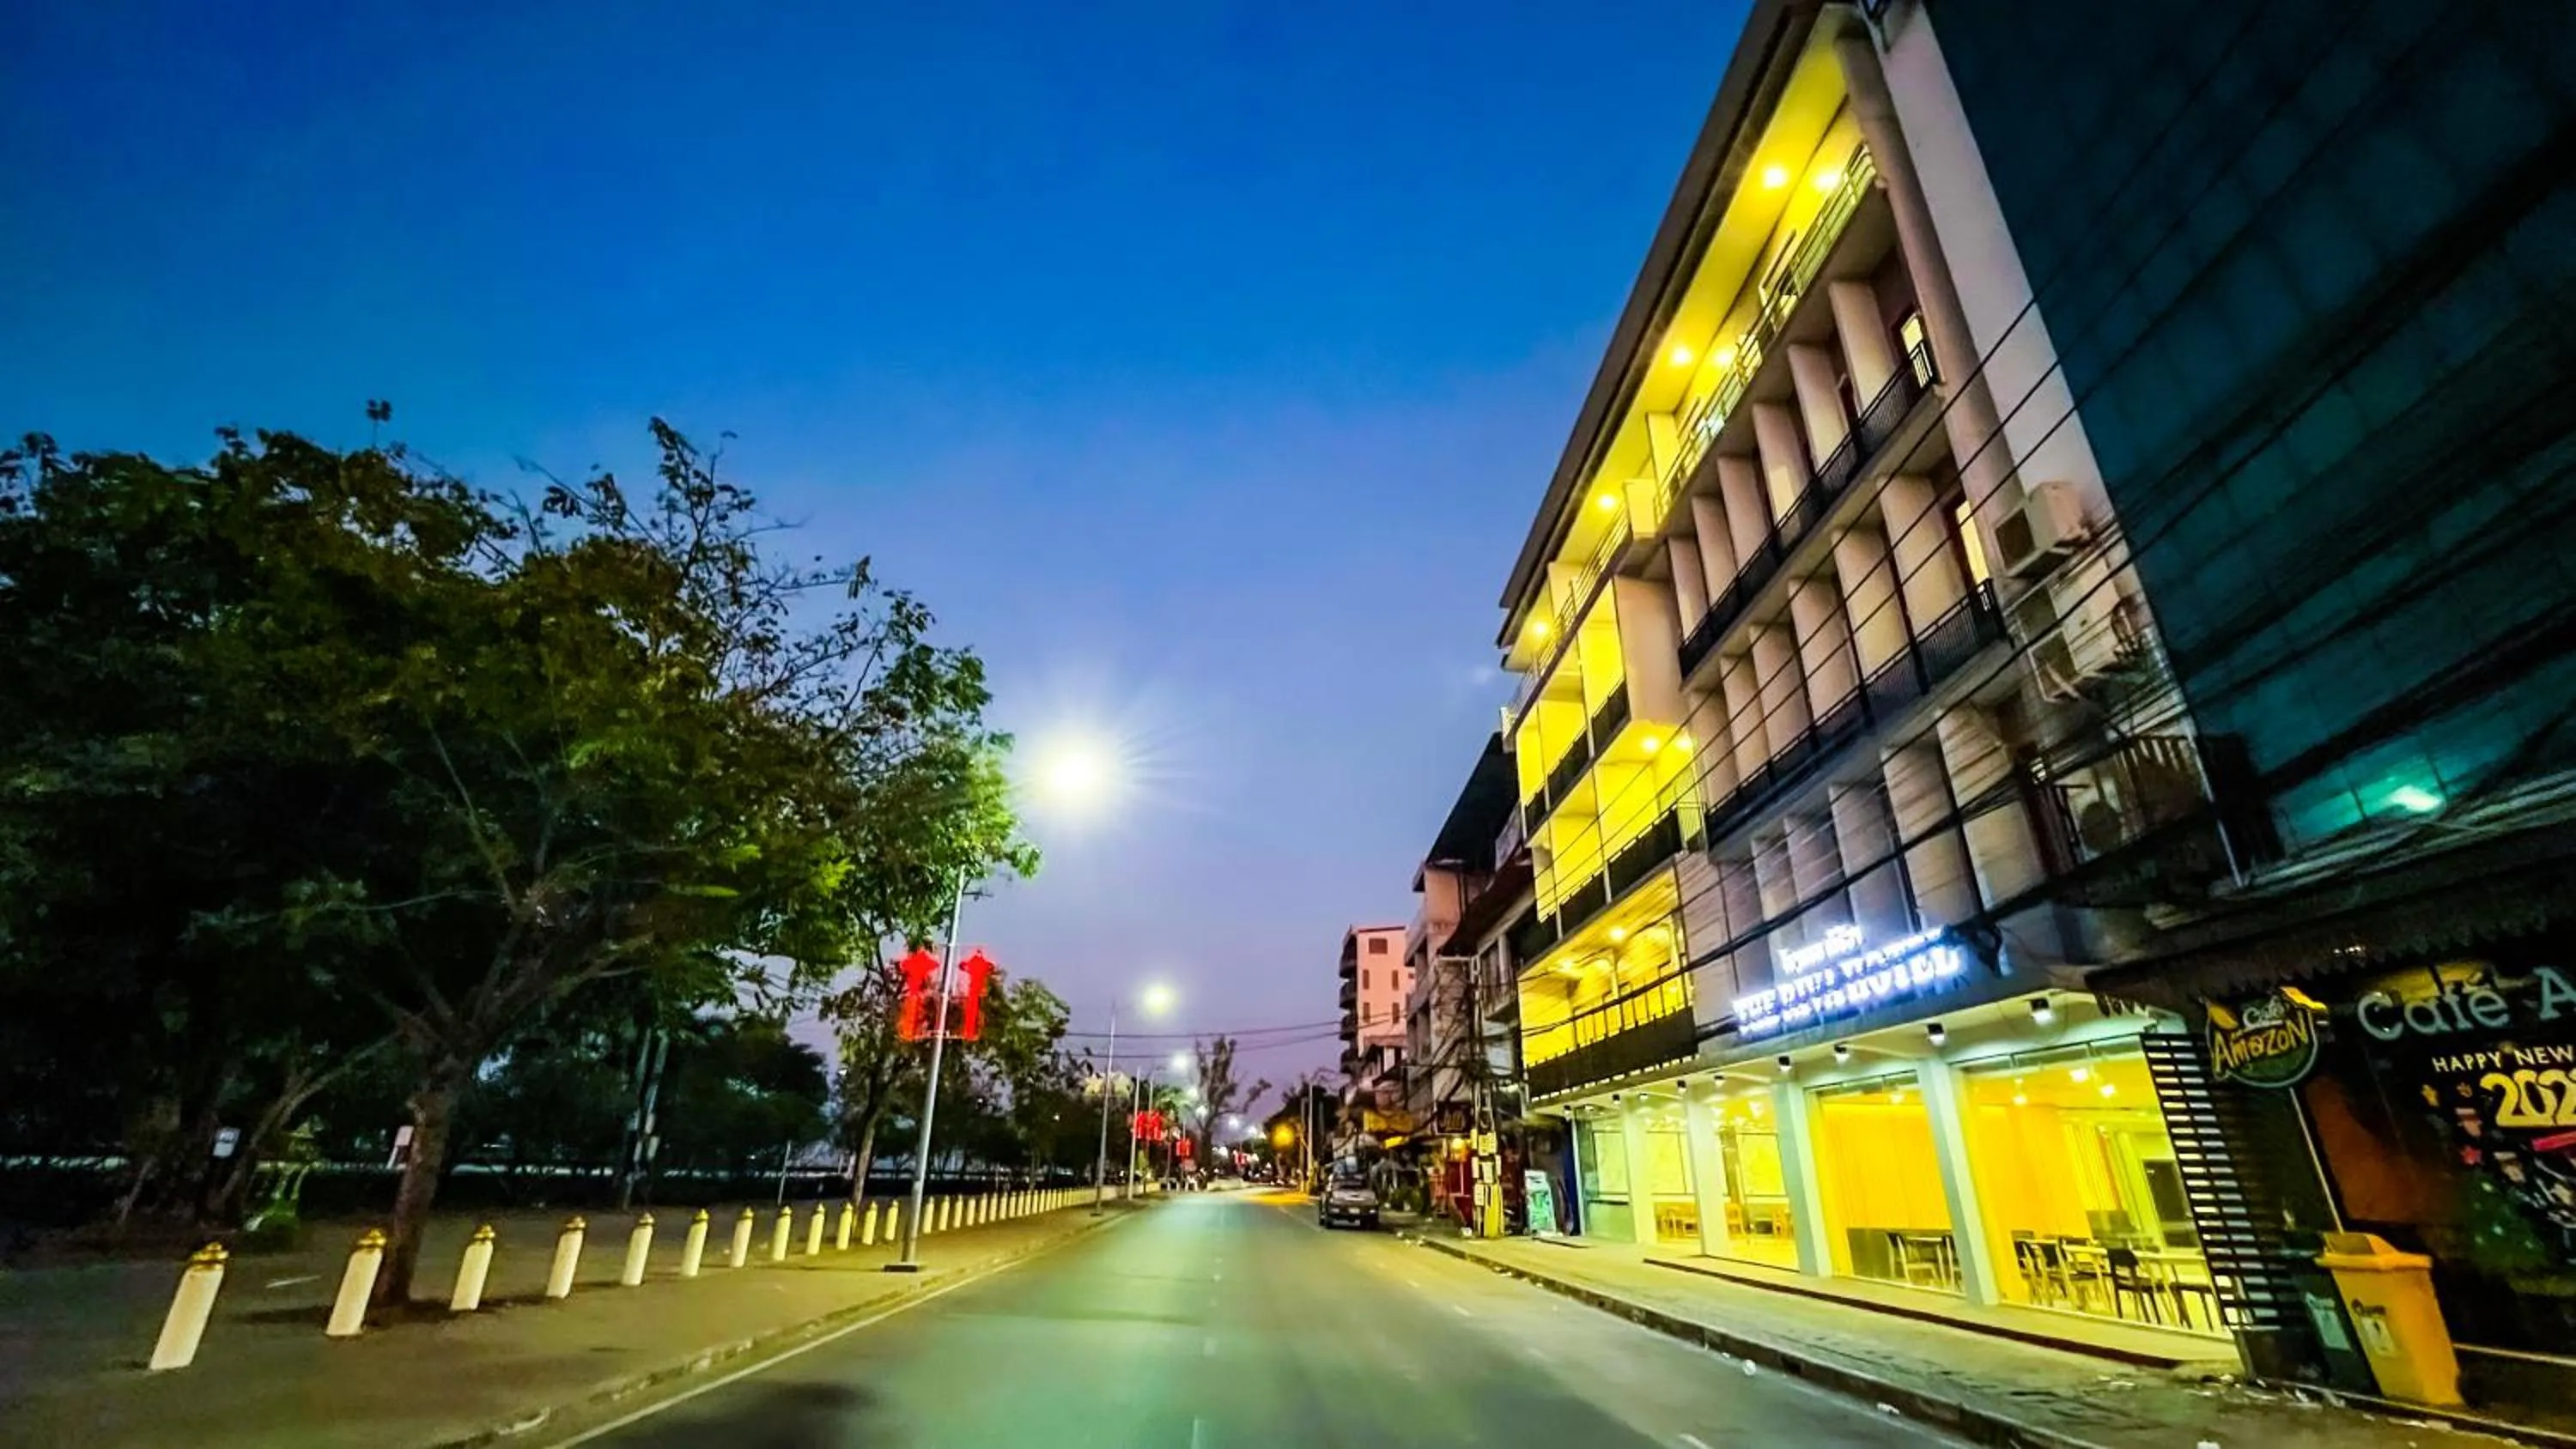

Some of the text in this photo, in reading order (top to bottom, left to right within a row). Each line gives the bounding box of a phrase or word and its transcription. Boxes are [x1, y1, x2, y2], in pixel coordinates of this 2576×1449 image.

[2357, 971, 2510, 1040] Café
[2432, 1043, 2575, 1073] HAPPY NEW
[2479, 1069, 2576, 1127] 202
